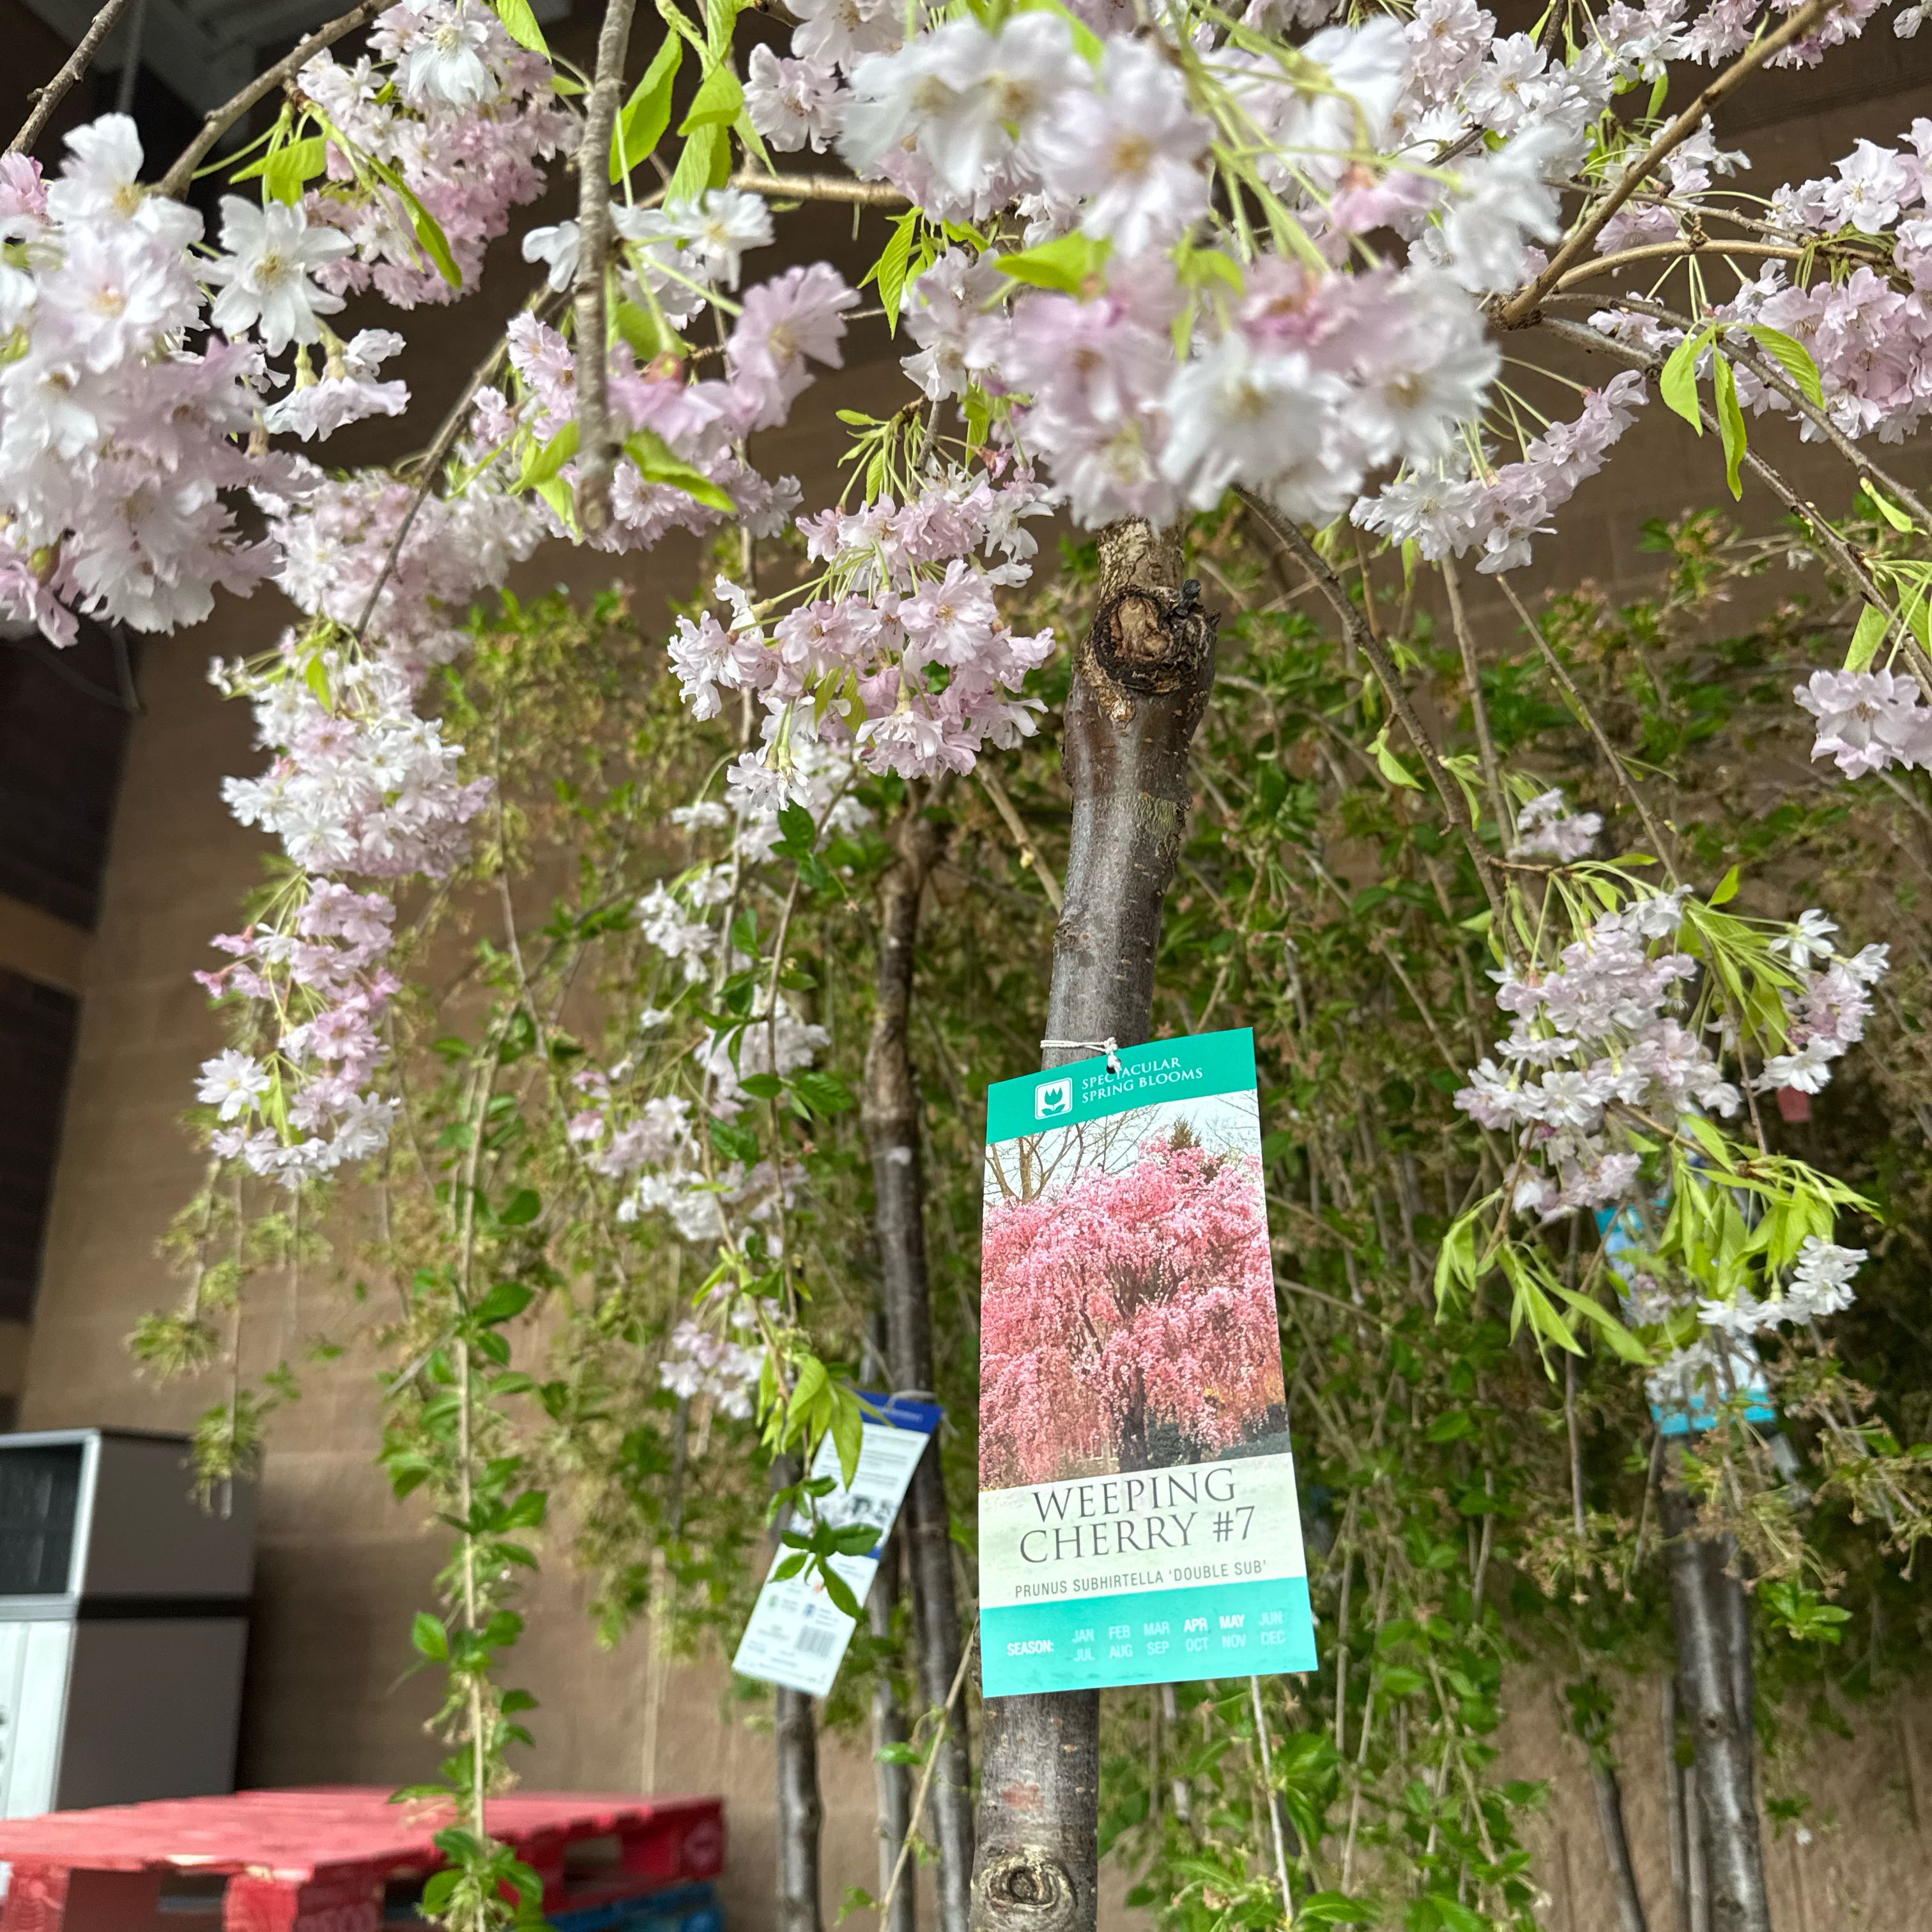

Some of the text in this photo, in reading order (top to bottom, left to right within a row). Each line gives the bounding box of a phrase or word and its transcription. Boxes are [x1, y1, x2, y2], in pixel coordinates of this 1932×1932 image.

[1082, 1057, 1181, 1089] SPECTACULAR
[1082, 1068, 1202, 1103] SPRING BLOOMS
[1032, 1468, 1236, 1522] WEEPING
[1020, 1505, 1255, 1563] CHERRY #7
[1015, 1581, 1068, 1598] PRUNUS
[1073, 1570, 1164, 1592] SUBHIRTELLA
[1073, 1611, 1284, 1644] JAN FEB MAR APR MAY JUN
[1006, 1639, 1054, 1657] SEASON:
[1073, 1630, 1286, 1662] JUL AUG SEP OCT NOV DEC
